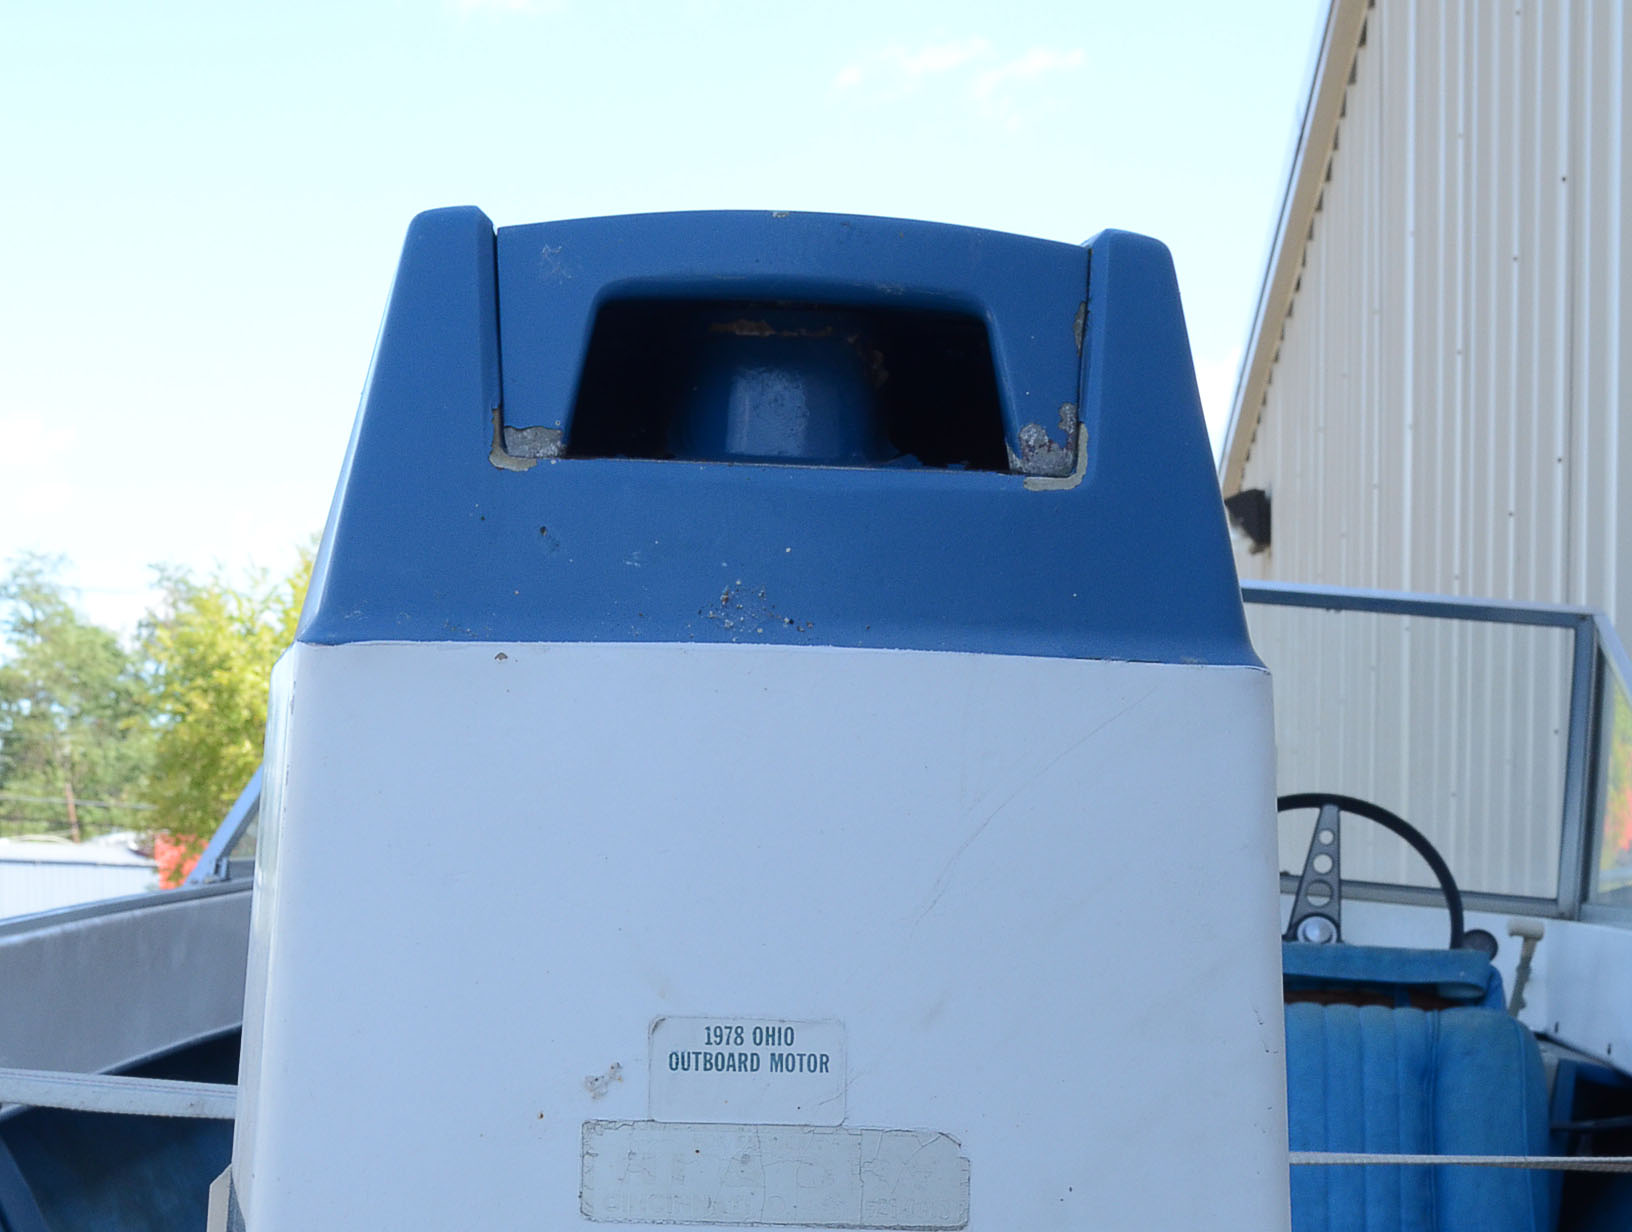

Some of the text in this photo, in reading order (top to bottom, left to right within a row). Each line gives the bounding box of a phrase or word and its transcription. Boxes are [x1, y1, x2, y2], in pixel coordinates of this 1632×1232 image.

[704, 1025, 795, 1047] 1978 OHIO
[668, 1050, 830, 1074] OUTBOARD MOTOR
